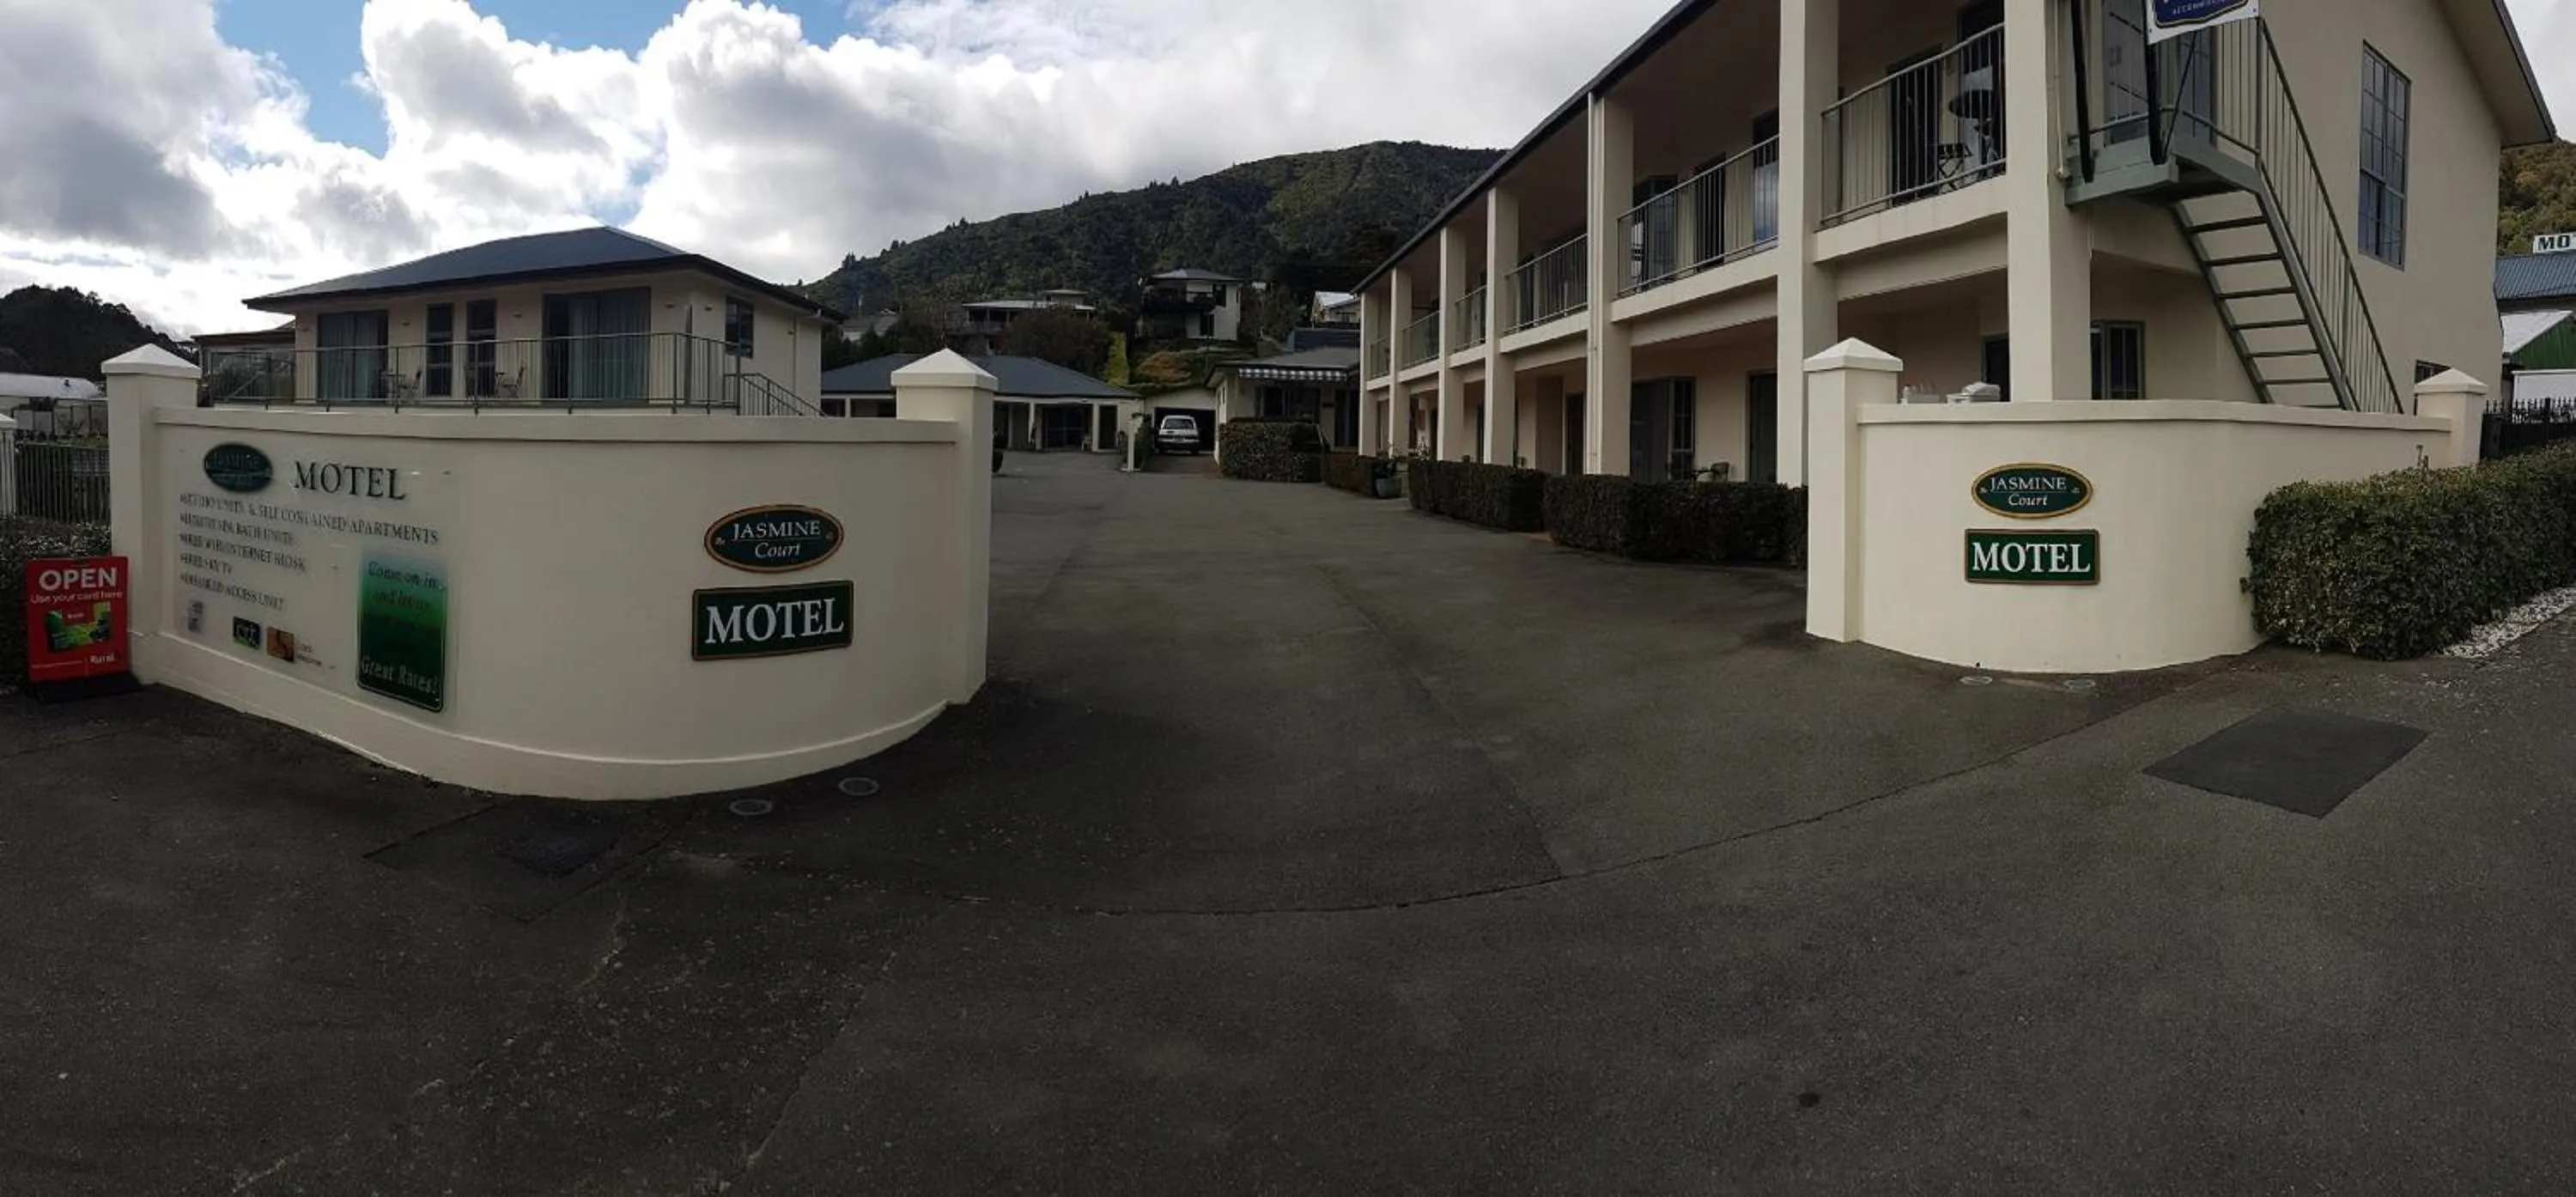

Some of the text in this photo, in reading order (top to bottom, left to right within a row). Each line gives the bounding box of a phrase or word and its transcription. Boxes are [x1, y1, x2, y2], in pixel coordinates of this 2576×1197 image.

[2538, 234, 2576, 251] MO
[294, 460, 407, 501] MOTEL
[1990, 477, 2067, 493] JASMINE
[2008, 493, 2048, 507] Court
[281, 507, 347, 532] CONTAINED
[349, 519, 440, 545] APARTMENTS
[732, 520, 822, 541] JASMINE
[274, 551, 307, 571] KIOSK
[755, 542, 800, 559] Court
[1971, 542, 2091, 573] MOTEL
[39, 567, 118, 592] OPEN
[368, 561, 401, 582] Come
[31, 590, 124, 605] Use your card here
[705, 598, 844, 644] MOTEL
[89, 652, 116, 665] Rural
[361, 655, 440, 695] Great Rates!
